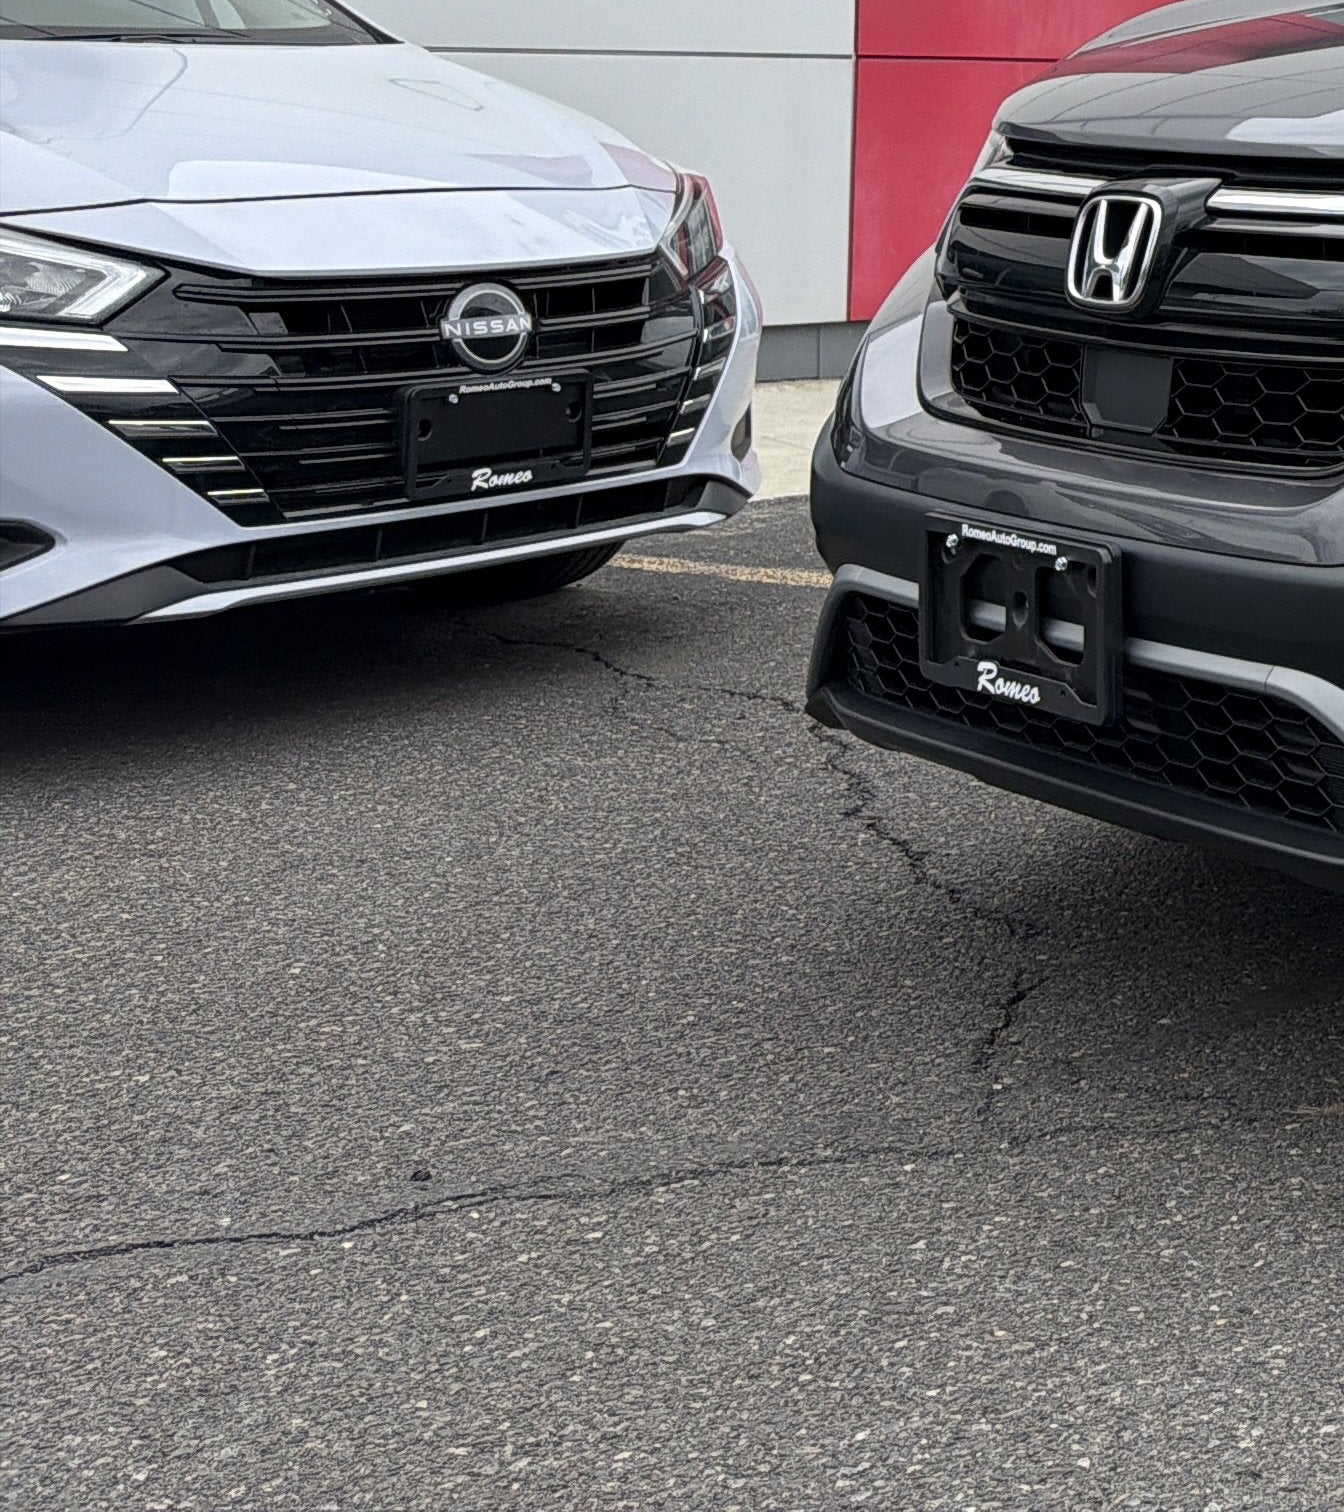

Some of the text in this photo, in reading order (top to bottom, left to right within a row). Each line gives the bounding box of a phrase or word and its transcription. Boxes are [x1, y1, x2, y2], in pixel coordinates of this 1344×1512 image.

[443, 319, 532, 337] NISSAN
[459, 377, 553, 395] RomeoAutoGroup.com
[470, 467, 533, 492] Romeo
[961, 523, 1058, 556] RomeoAutoGroup.com
[976, 660, 1041, 705] Romeo
